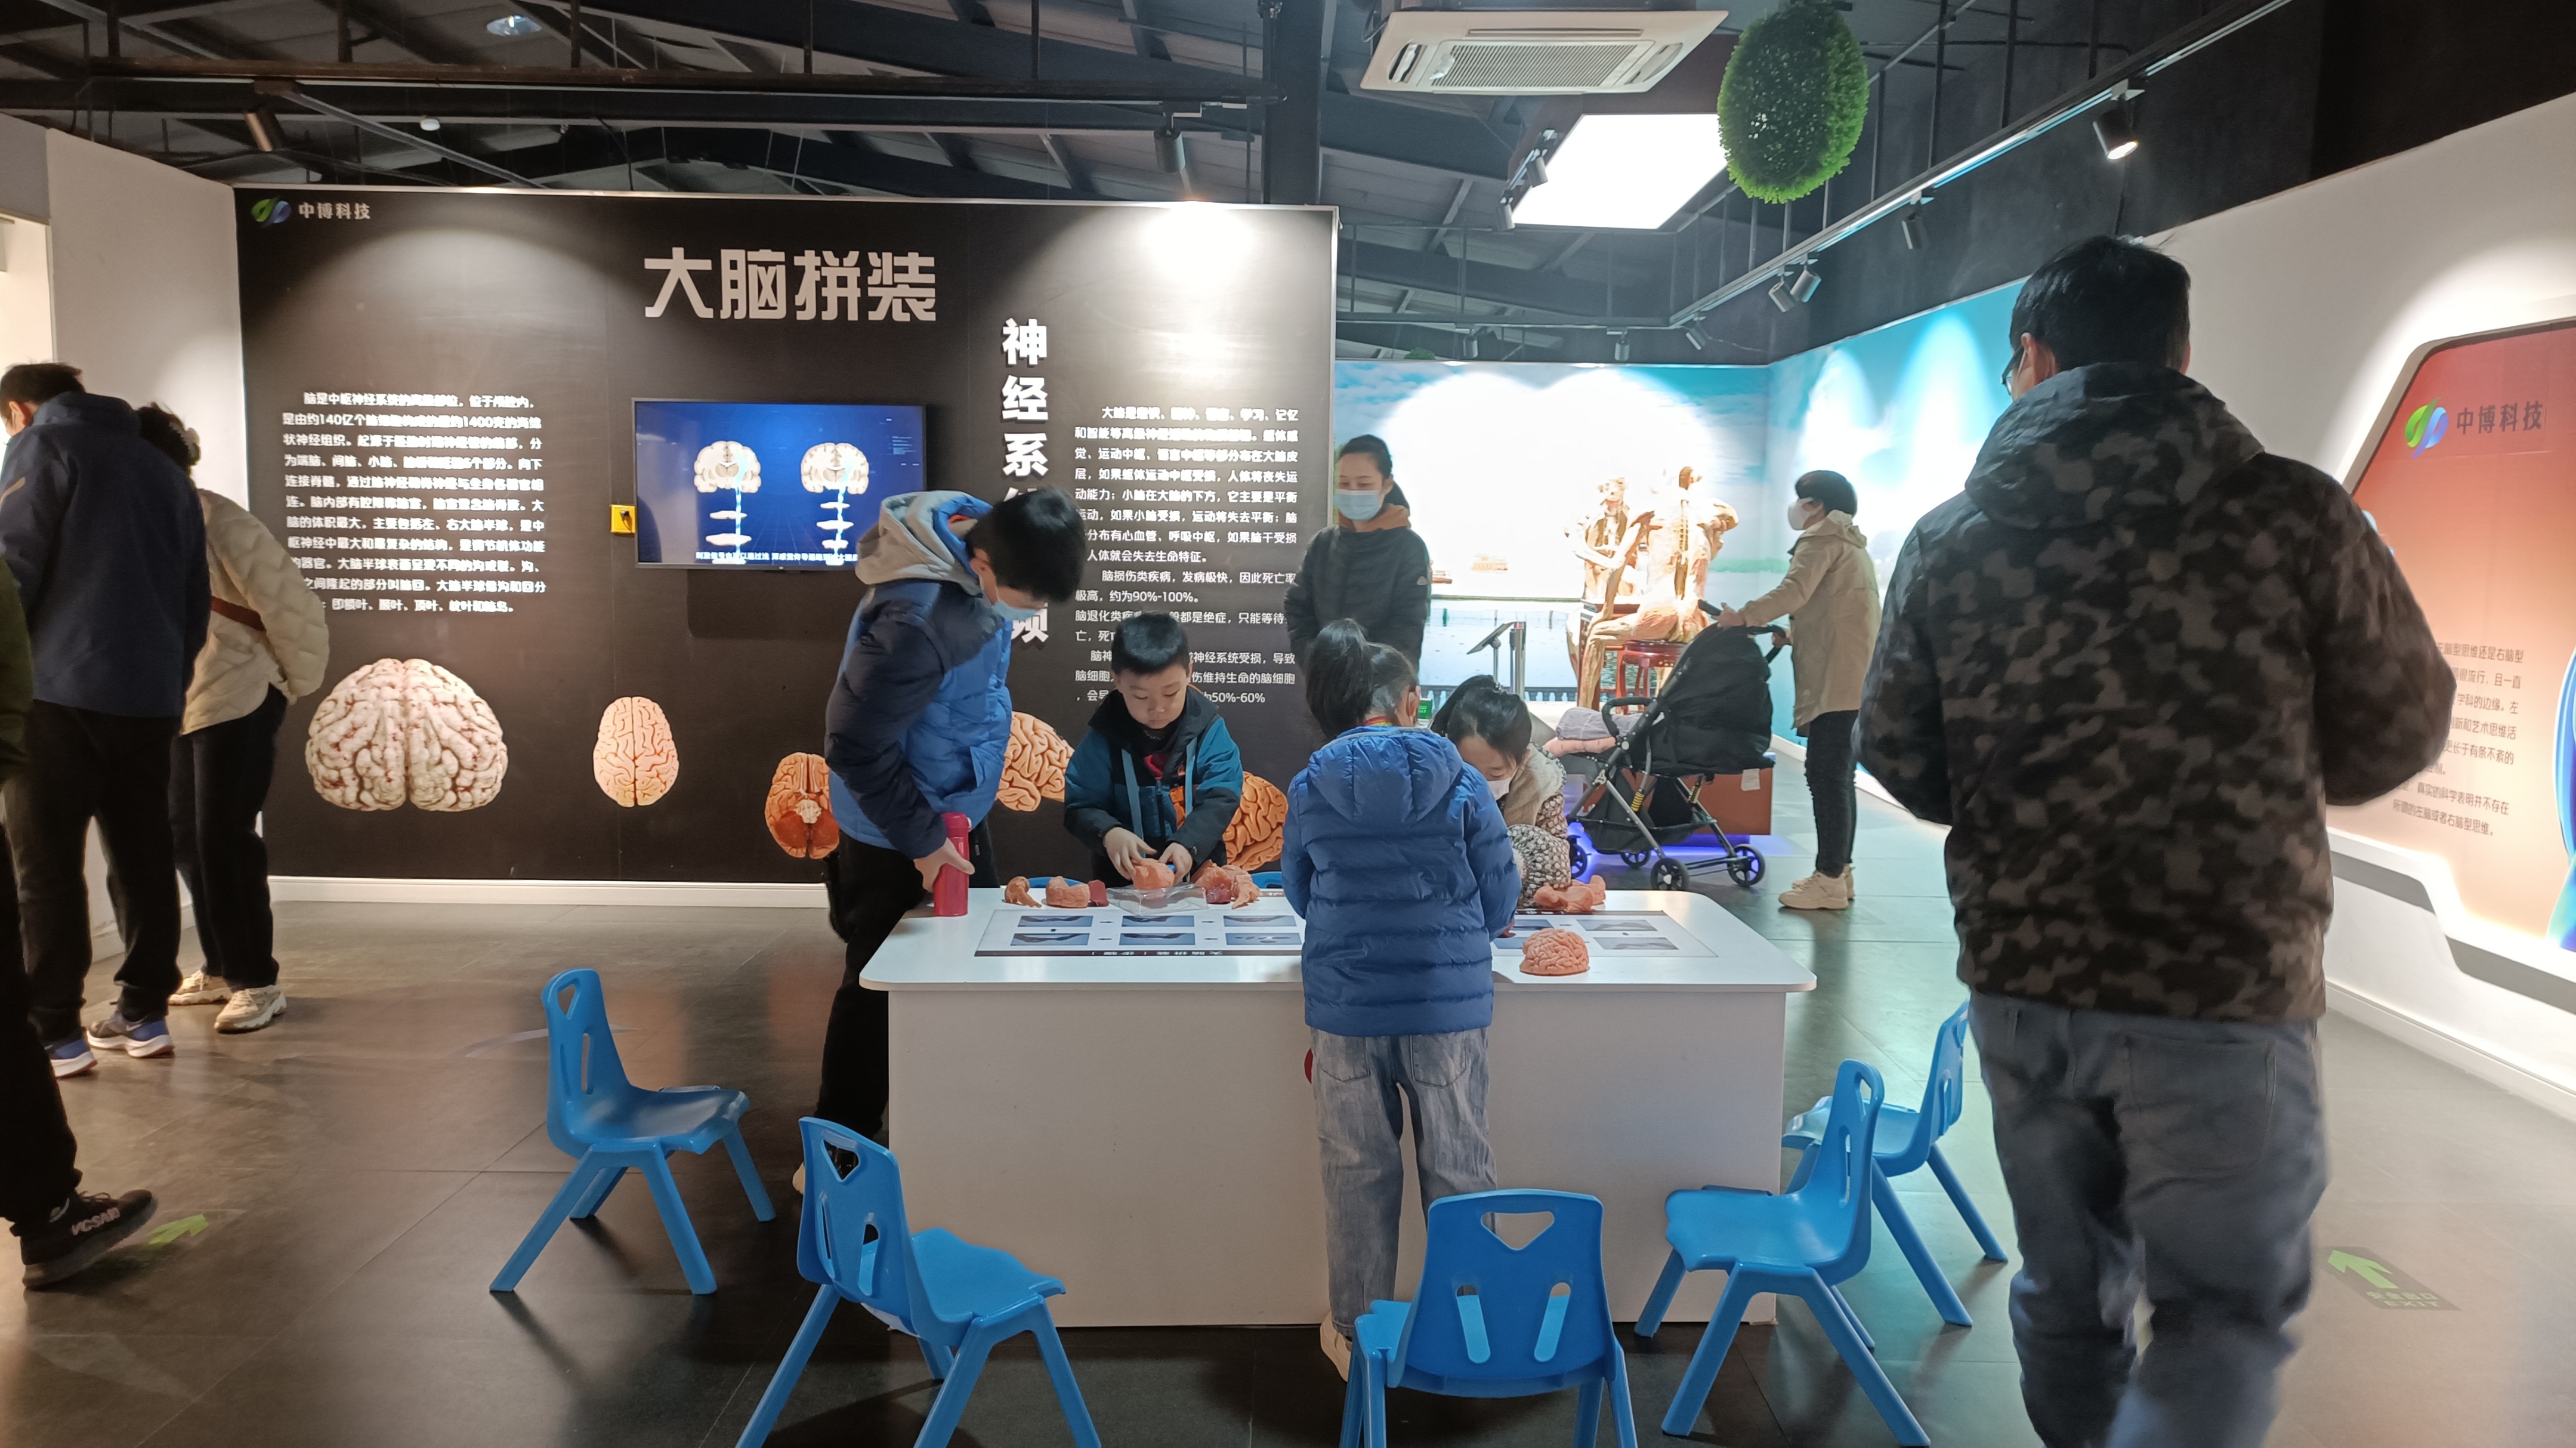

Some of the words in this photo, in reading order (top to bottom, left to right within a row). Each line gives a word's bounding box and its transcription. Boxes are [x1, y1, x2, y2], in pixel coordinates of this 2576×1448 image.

[298, 202, 371, 220] 中博科技
[644, 246, 937, 322] 大脑拼装
[2456, 400, 2543, 435] 中博科技
[1002, 317, 1049, 643] 神经系频
[1087, 529, 1298, 544] 分布有心血管、呼吸中枢，如果脑干受损
[1075, 589, 1199, 603] 极高，约为90%-100%。
[2454, 693, 2519, 715] 学科的边缘。左
